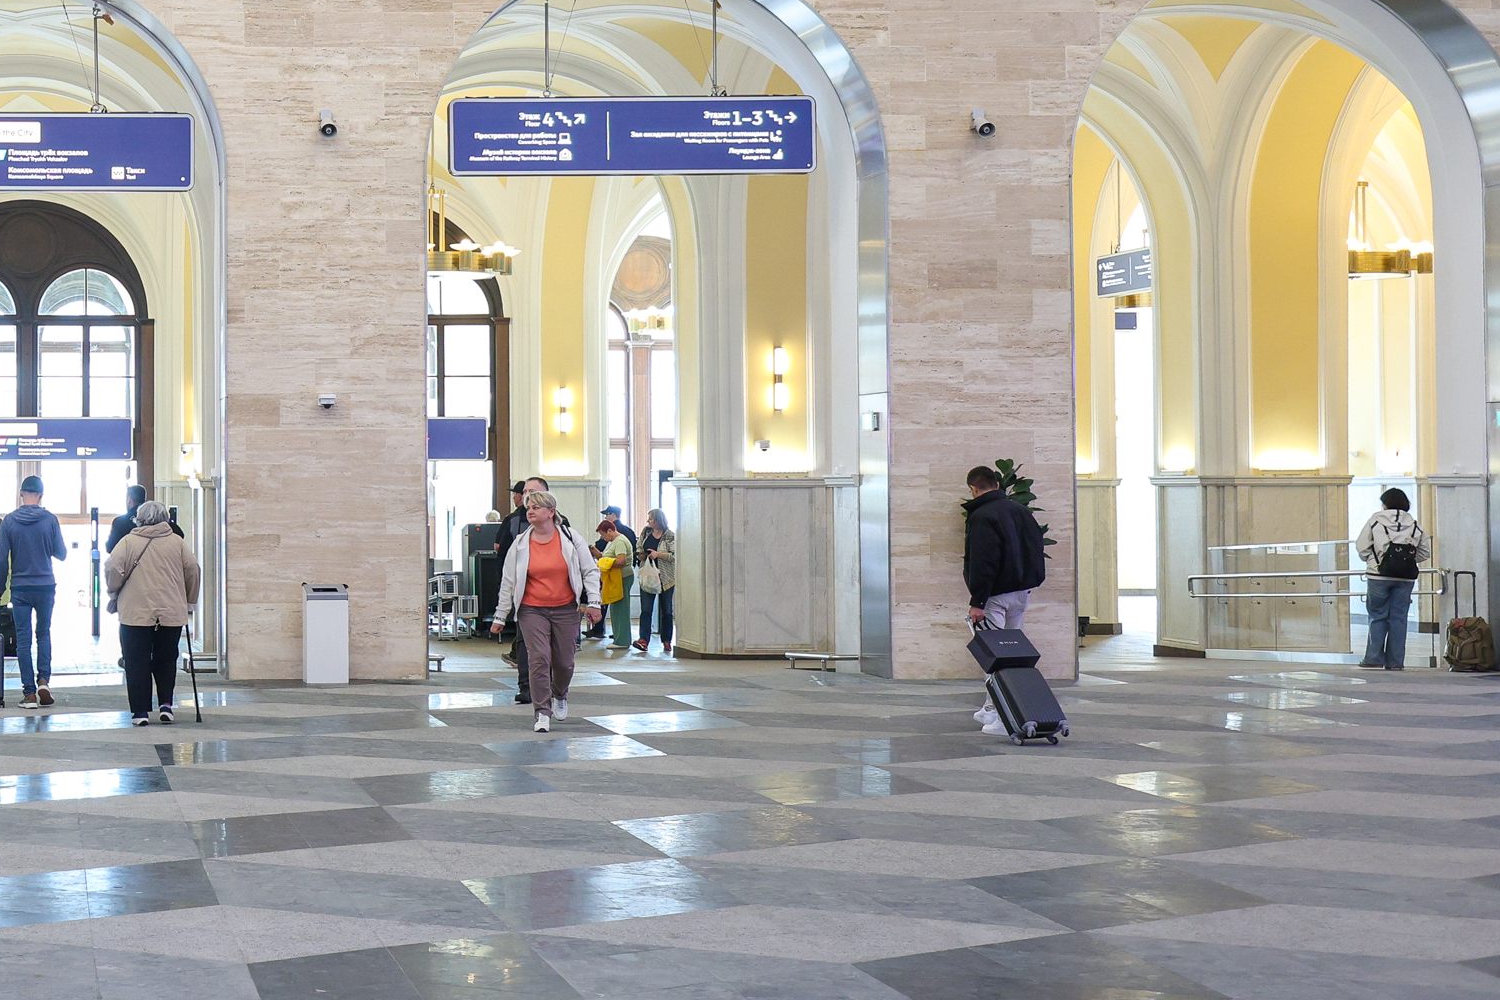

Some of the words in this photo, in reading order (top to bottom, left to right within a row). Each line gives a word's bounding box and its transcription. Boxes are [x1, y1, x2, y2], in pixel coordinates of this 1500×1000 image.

[704, 111, 730, 119] Этажи
[519, 112, 541, 120] Этаж
[542, 112, 554, 127] 4
[2, 129, 16, 137] the
[17, 129, 34, 138] City
[474, 132, 519, 140] Пространство
[532, 132, 557, 140] работы
[8, 149, 40, 157] Площадь
[482, 149, 504, 157] Музей
[728, 147, 771, 155] Лаундж-зона
